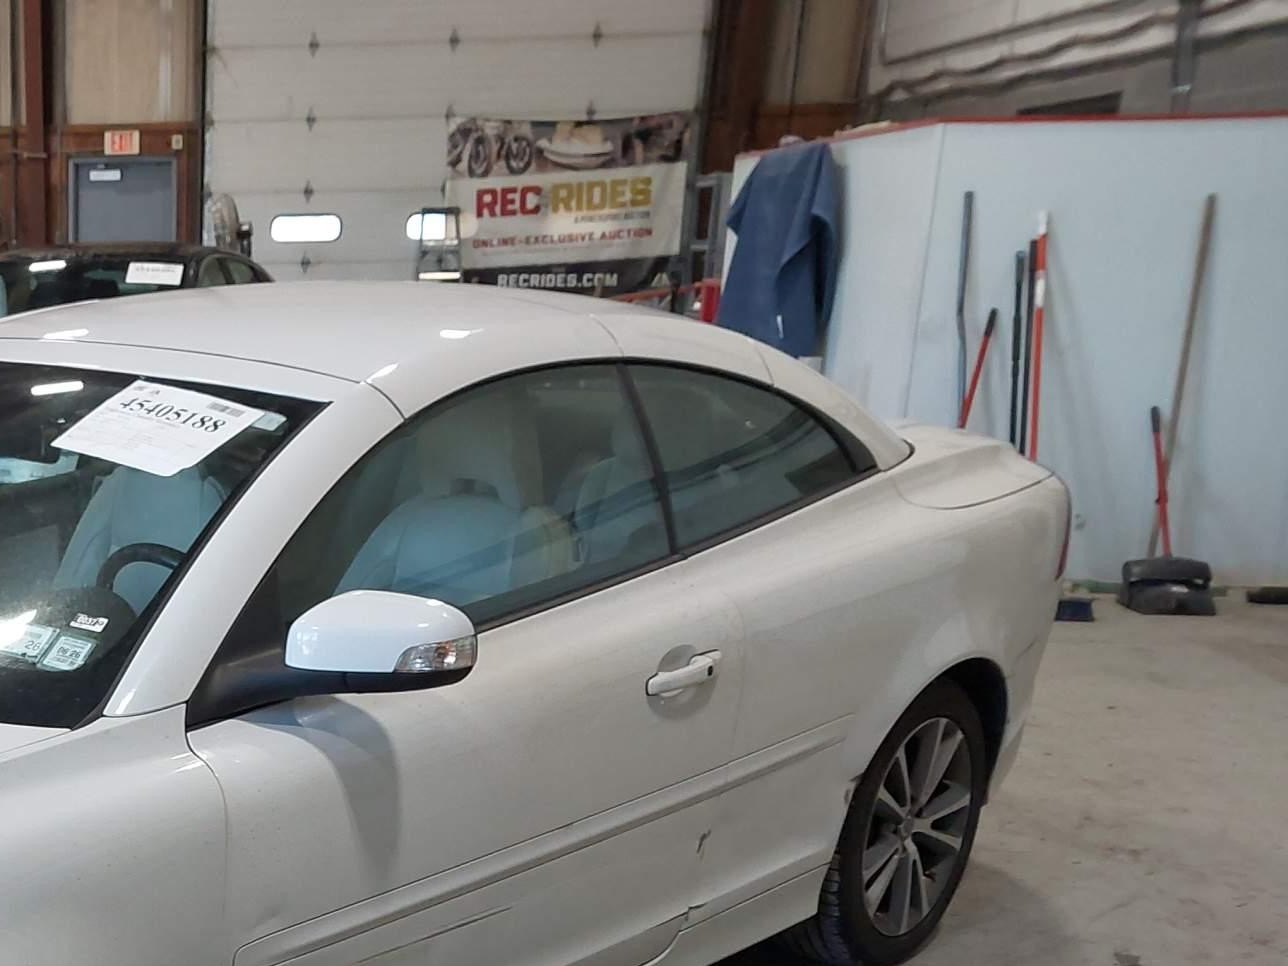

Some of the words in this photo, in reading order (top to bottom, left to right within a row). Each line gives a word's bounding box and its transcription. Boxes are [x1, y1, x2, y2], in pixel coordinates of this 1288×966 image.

[476, 185, 542, 219] REC
[551, 176, 652, 213] RIDES
[472, 232, 595, 249] ONLINE-EXCLUSIVE
[599, 227, 653, 241] AUCTION
[496, 272, 619, 289] RECRIDES.COM
[119, 397, 227, 433] 45405188
